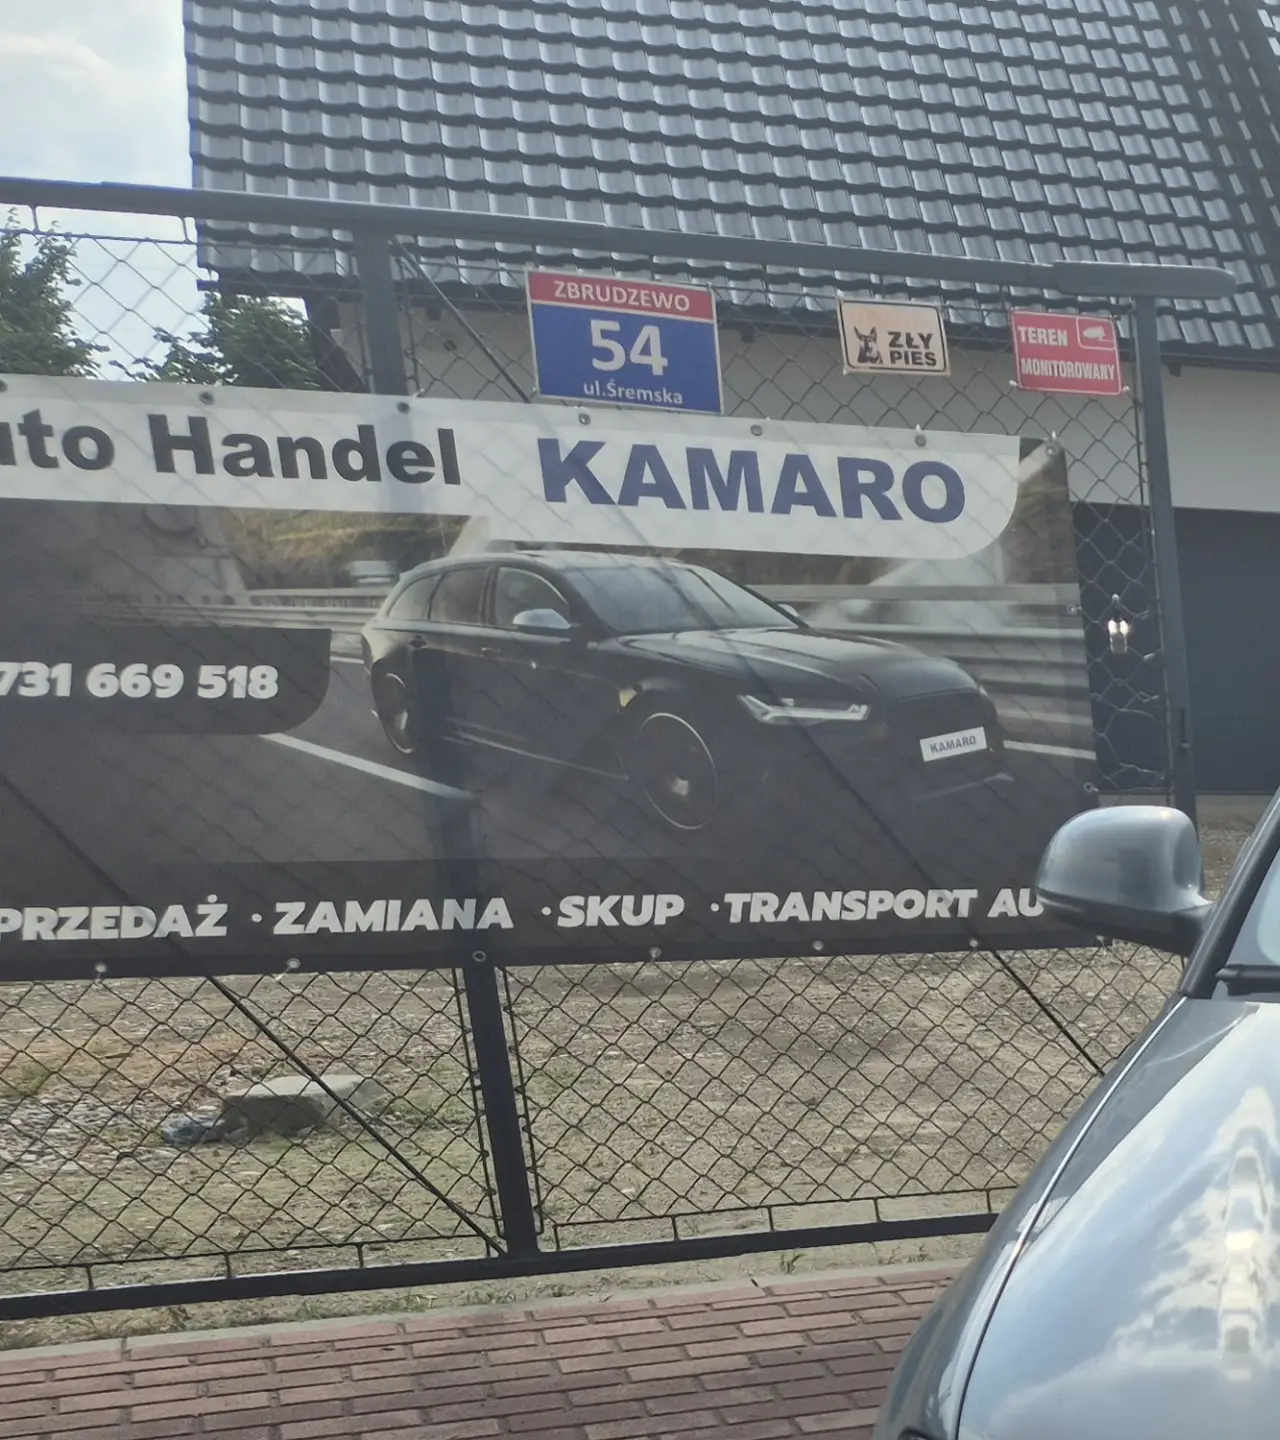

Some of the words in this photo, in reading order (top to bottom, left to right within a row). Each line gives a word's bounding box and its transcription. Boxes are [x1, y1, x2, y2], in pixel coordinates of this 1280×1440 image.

[553, 280, 691, 312] ZBRUDZEWO
[590, 319, 668, 376] 54
[887, 331, 934, 350] ZŁY
[1017, 326, 1068, 346] TEREN
[890, 351, 937, 367] PIES
[1020, 357, 1116, 381] MONITOROWANY
[148, 413, 462, 485] Handel
[537, 438, 966, 523] KAMARO
[0, 661, 72, 697] 731
[86, 663, 184, 698] 669
[197, 664, 279, 699] 518
[929, 735, 977, 754] KAMARO
[273, 897, 514, 935] ZAMIANA
[557, 893, 685, 928] SKUP
[724, 888, 978, 923] TRANSPORT
